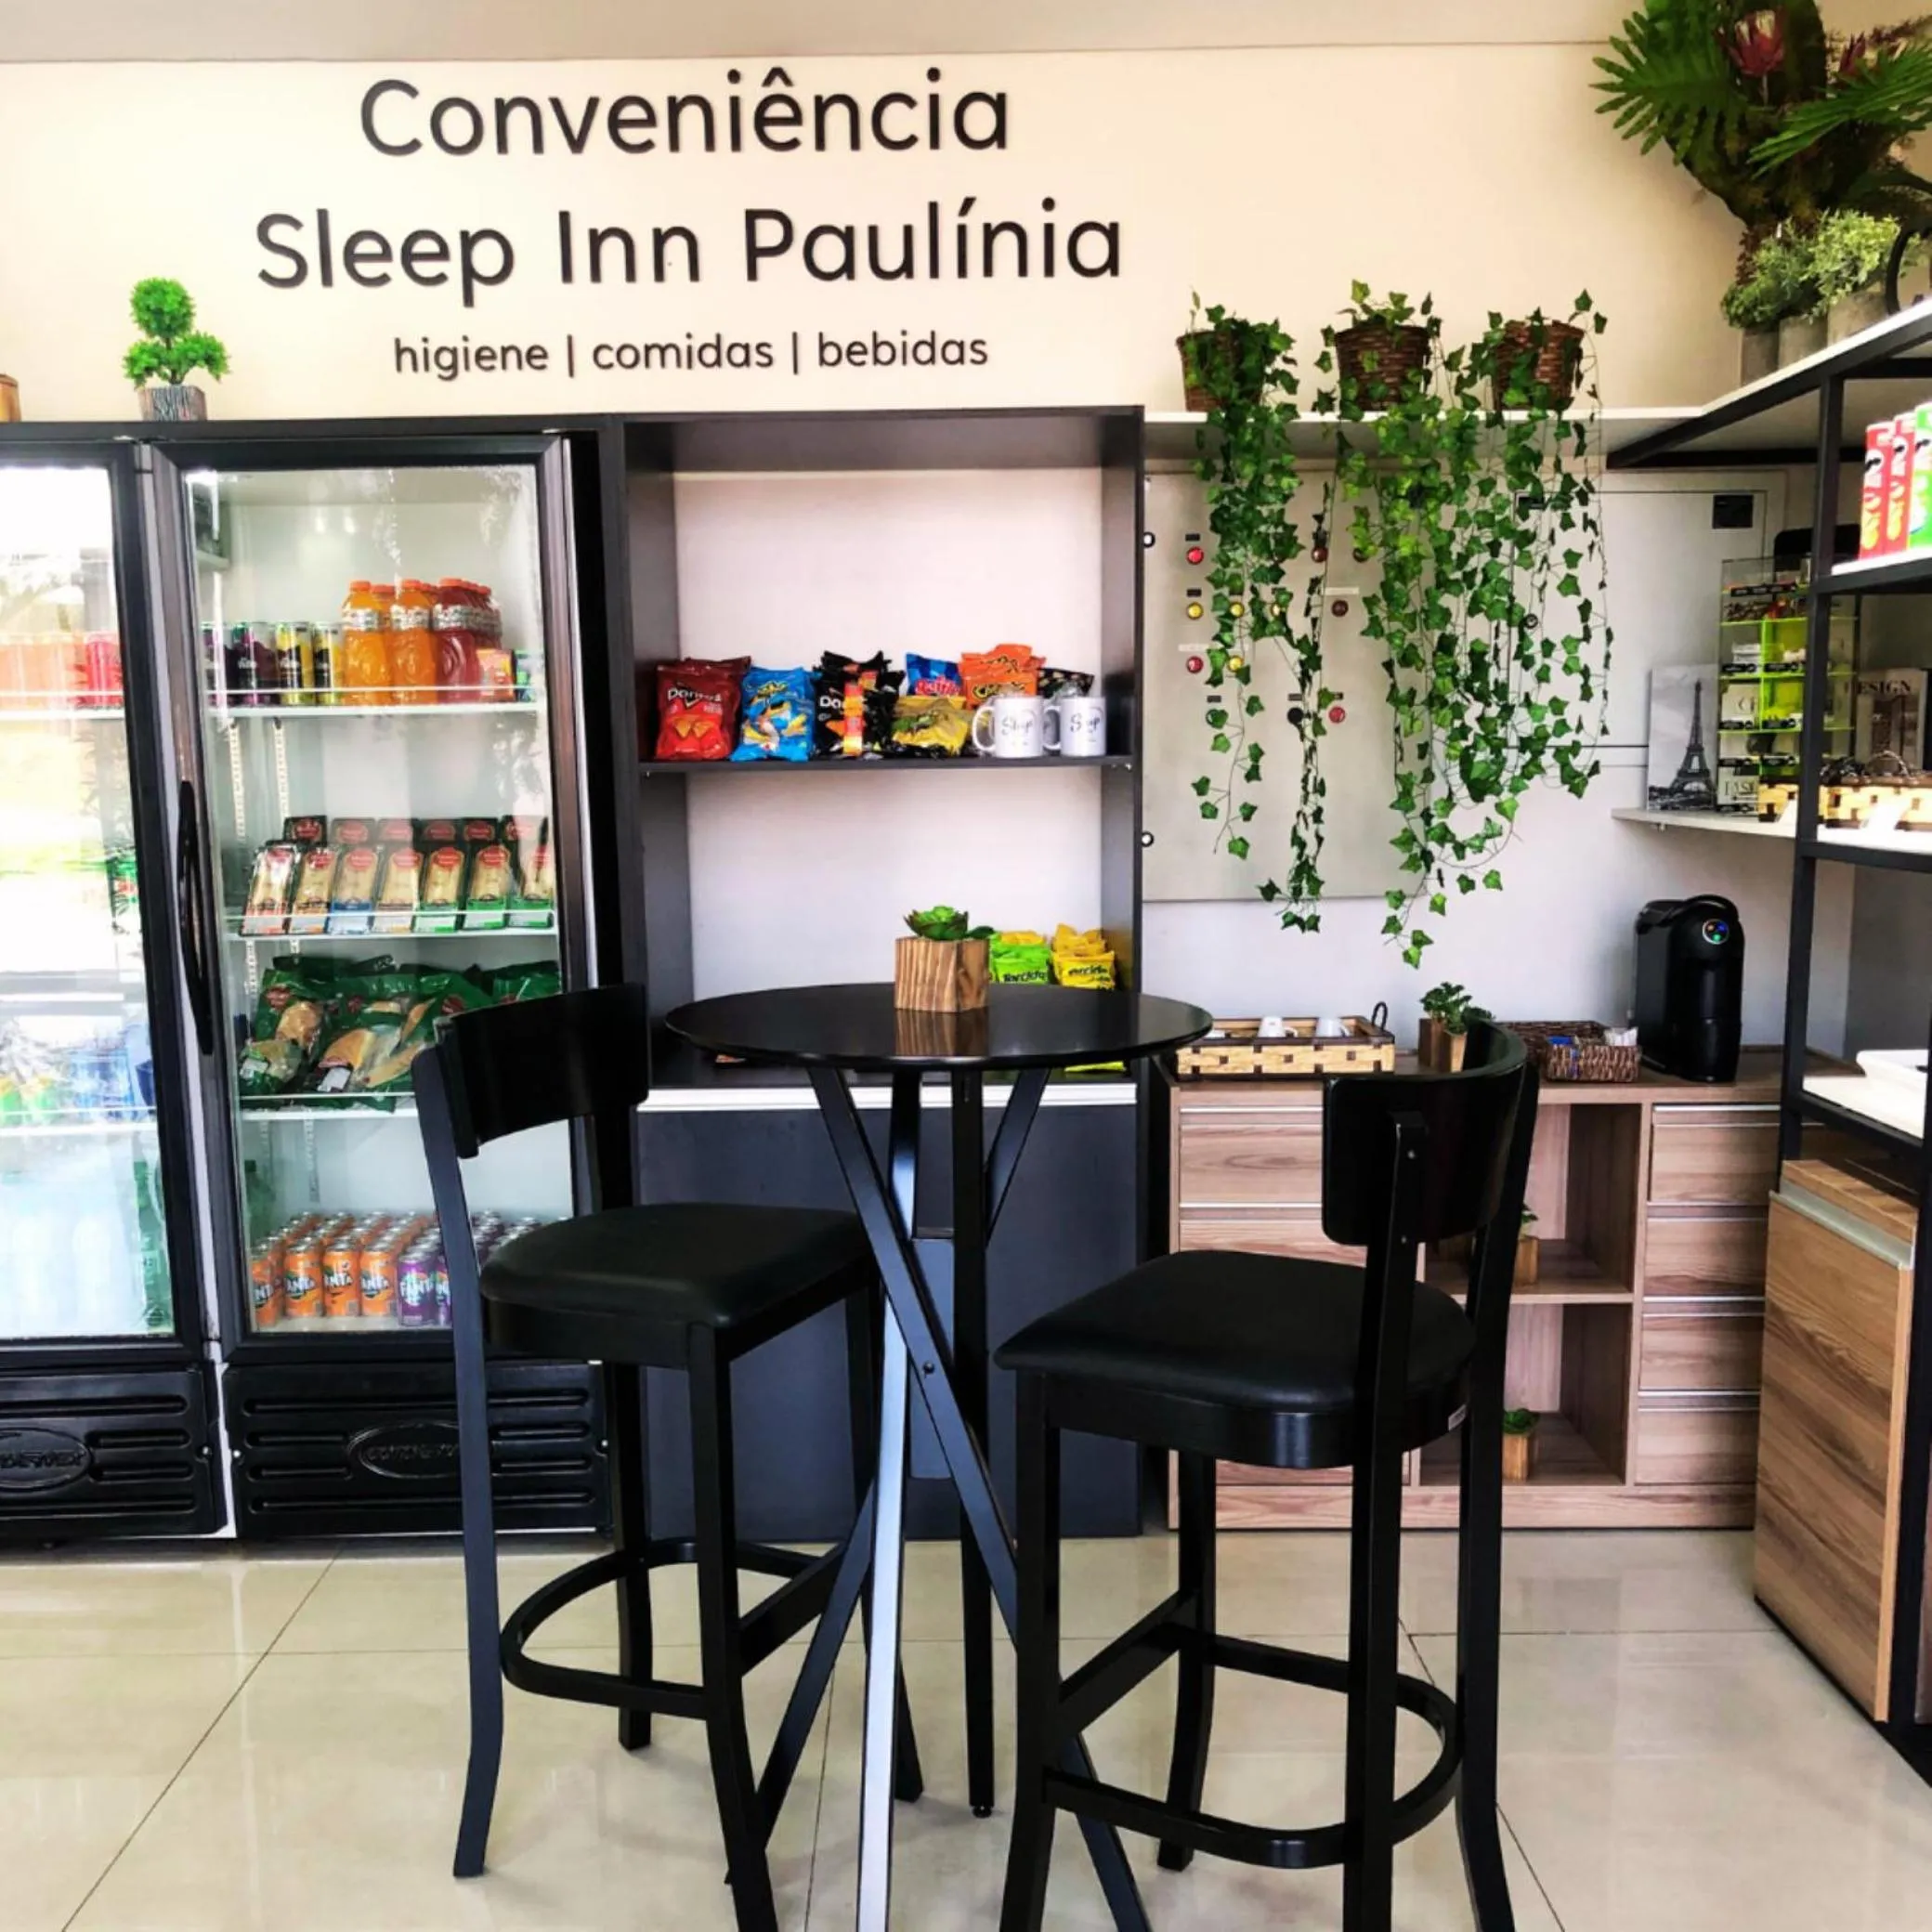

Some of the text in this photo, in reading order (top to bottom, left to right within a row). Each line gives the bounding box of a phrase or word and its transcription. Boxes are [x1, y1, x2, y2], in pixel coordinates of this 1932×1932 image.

[360, 66, 1008, 156] Conveniência
[256, 196, 1120, 307] Sleep Inn Paulínia
[395, 335, 549, 382] higiene
[593, 333, 774, 370] comidas
[818, 330, 988, 367] bebidas
